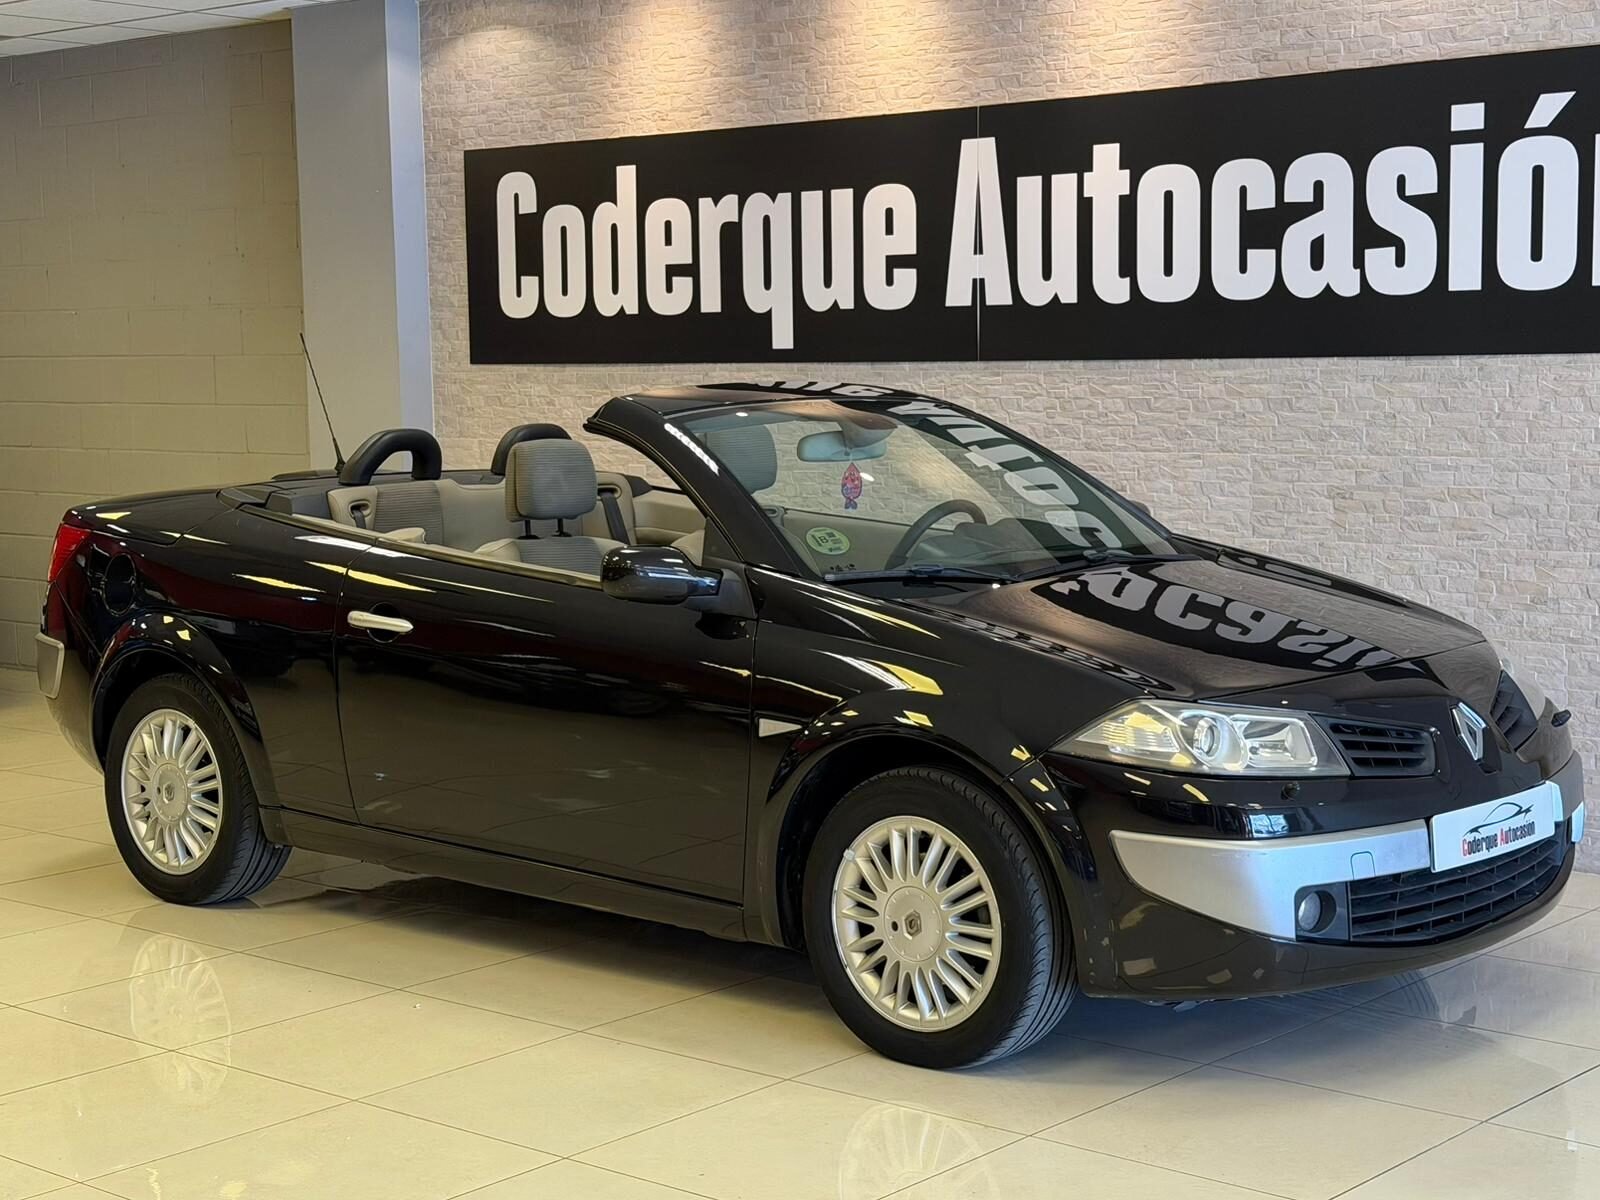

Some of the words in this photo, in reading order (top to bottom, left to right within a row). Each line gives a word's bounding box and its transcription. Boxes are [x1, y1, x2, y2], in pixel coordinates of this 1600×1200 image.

[497, 165, 917, 350] Coderque
[945, 91, 1600, 307] Autocasió
[1462, 833, 1498, 856] Coderque
[1500, 820, 1536, 846] Autocasión
